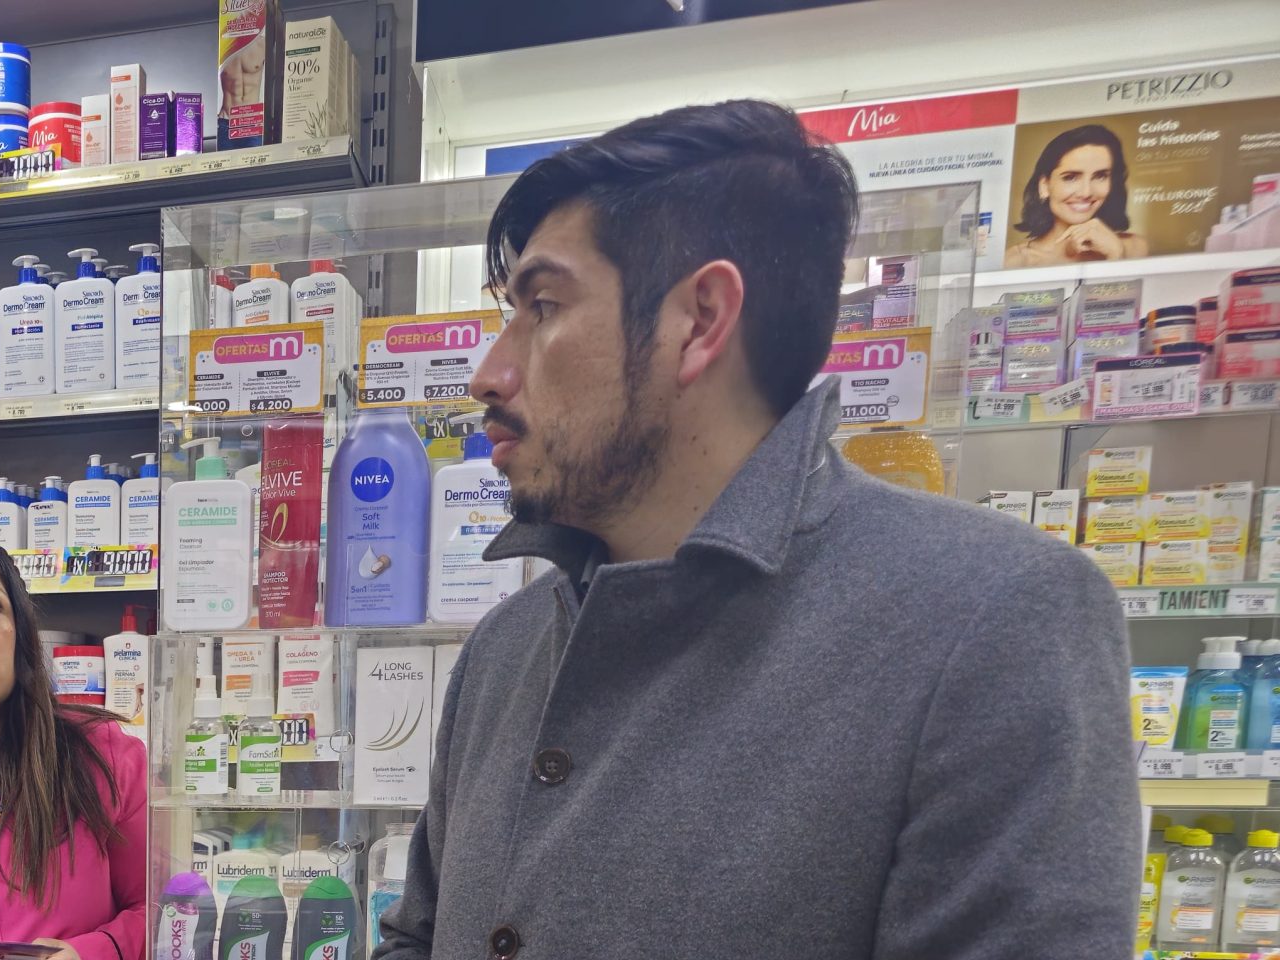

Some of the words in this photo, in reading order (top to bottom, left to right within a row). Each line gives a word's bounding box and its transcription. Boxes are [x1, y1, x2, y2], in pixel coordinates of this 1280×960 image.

[287, 59, 320, 77] 90%
[1106, 69, 1234, 101] PETRIZZIO
[848, 106, 901, 137] Mia
[1138, 120, 1180, 134] Cuida
[31, 126, 57, 148] Mia
[1137, 137, 1158, 149] las
[1159, 129, 1220, 146] historias
[3, 302, 45, 312] DermoCream
[62, 296, 104, 308] DermoCream
[235, 294, 272, 308] DermoCream
[388, 332, 444, 345] OFERTAS
[216, 344, 268, 357] OFERTAS
[354, 475, 390, 486] NIVEA
[75, 495, 111, 504] CERAMIDE
[178, 506, 238, 517] CERAMIDE
[362, 512, 380, 521] Soft
[34, 515, 59, 523] CERAMIDE
[362, 522, 380, 531] Milk
[384, 662, 412, 671] LONG
[384, 672, 424, 681] LASHES
[217, 863, 265, 876] Lubriderm
